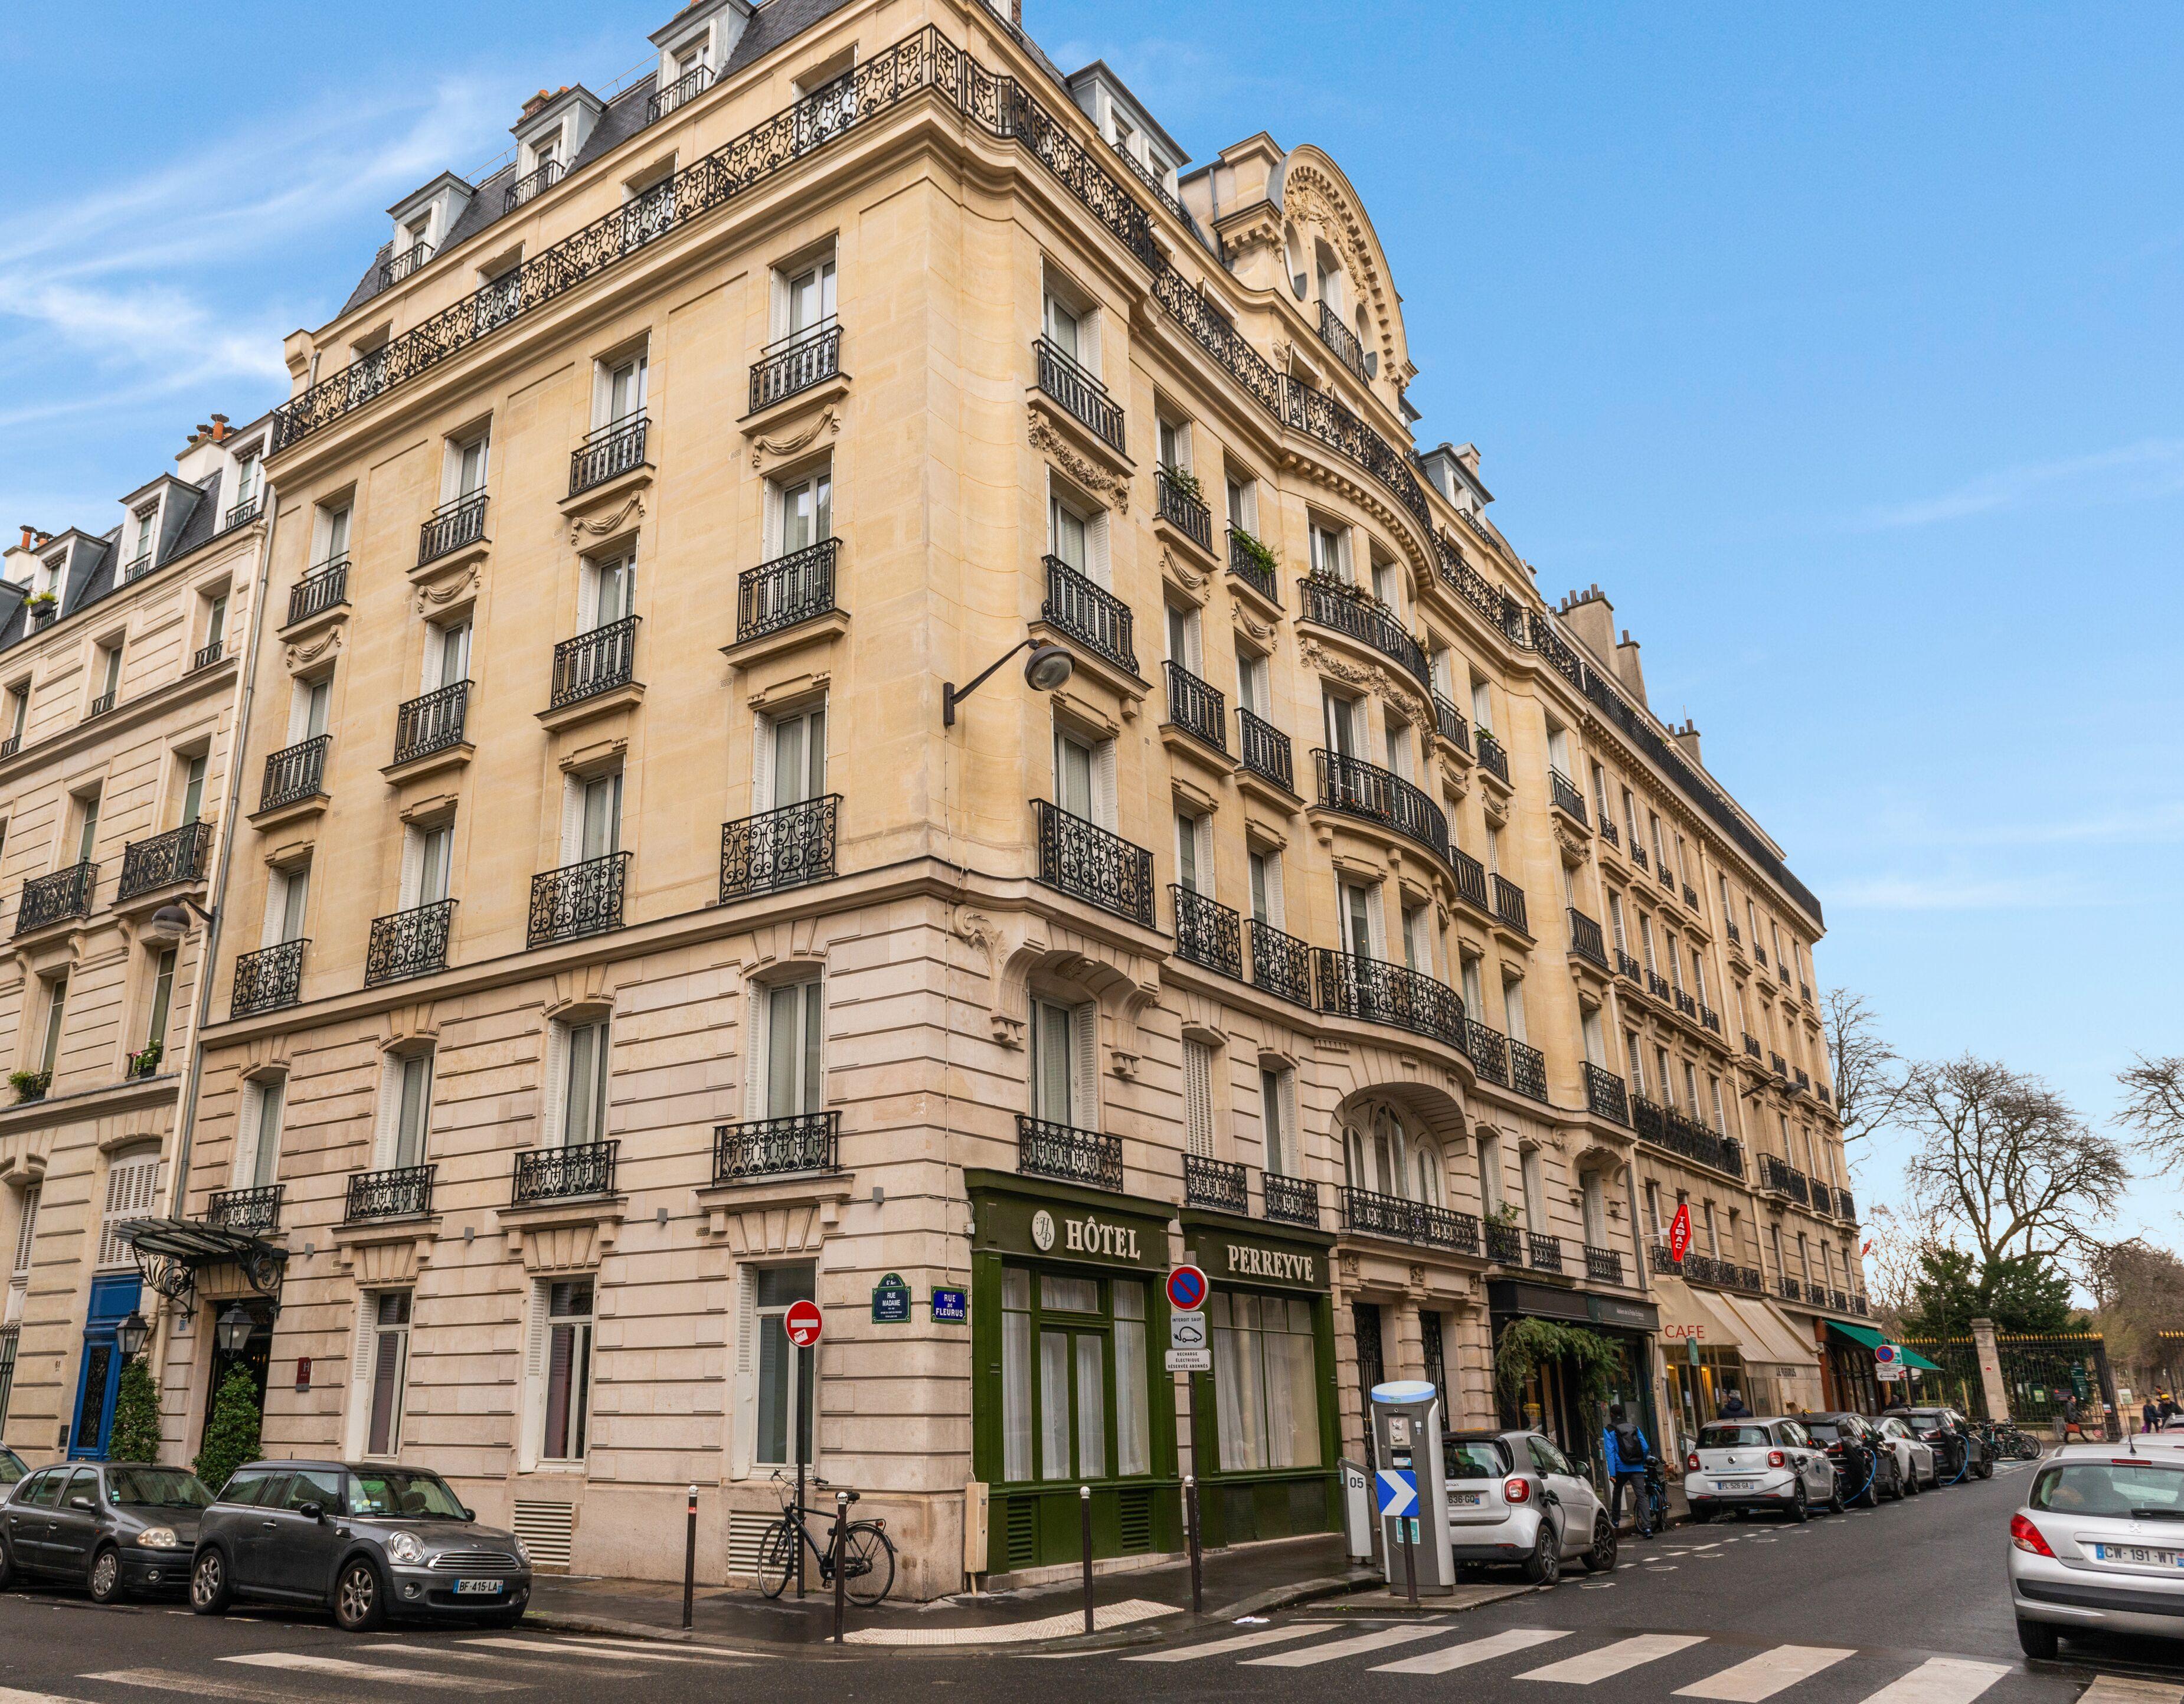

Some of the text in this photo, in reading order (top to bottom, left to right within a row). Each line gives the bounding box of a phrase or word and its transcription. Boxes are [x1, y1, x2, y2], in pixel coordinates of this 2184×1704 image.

[1065, 1215, 1140, 1260] HÔTEL
[1675, 1216, 1686, 1249] TABAC
[1227, 1245, 1314, 1283] PERREYVE
[944, 1294, 956, 1302] RUE
[936, 1307, 963, 1317] FLEURUS
[1665, 1324, 1705, 1339] CAFE
[303, 1362, 310, 1372] H
[1776, 1367, 1781, 1376] LE
[1349, 1477, 1364, 1489] 05
[459, 1581, 498, 1592] BF-415-LA
